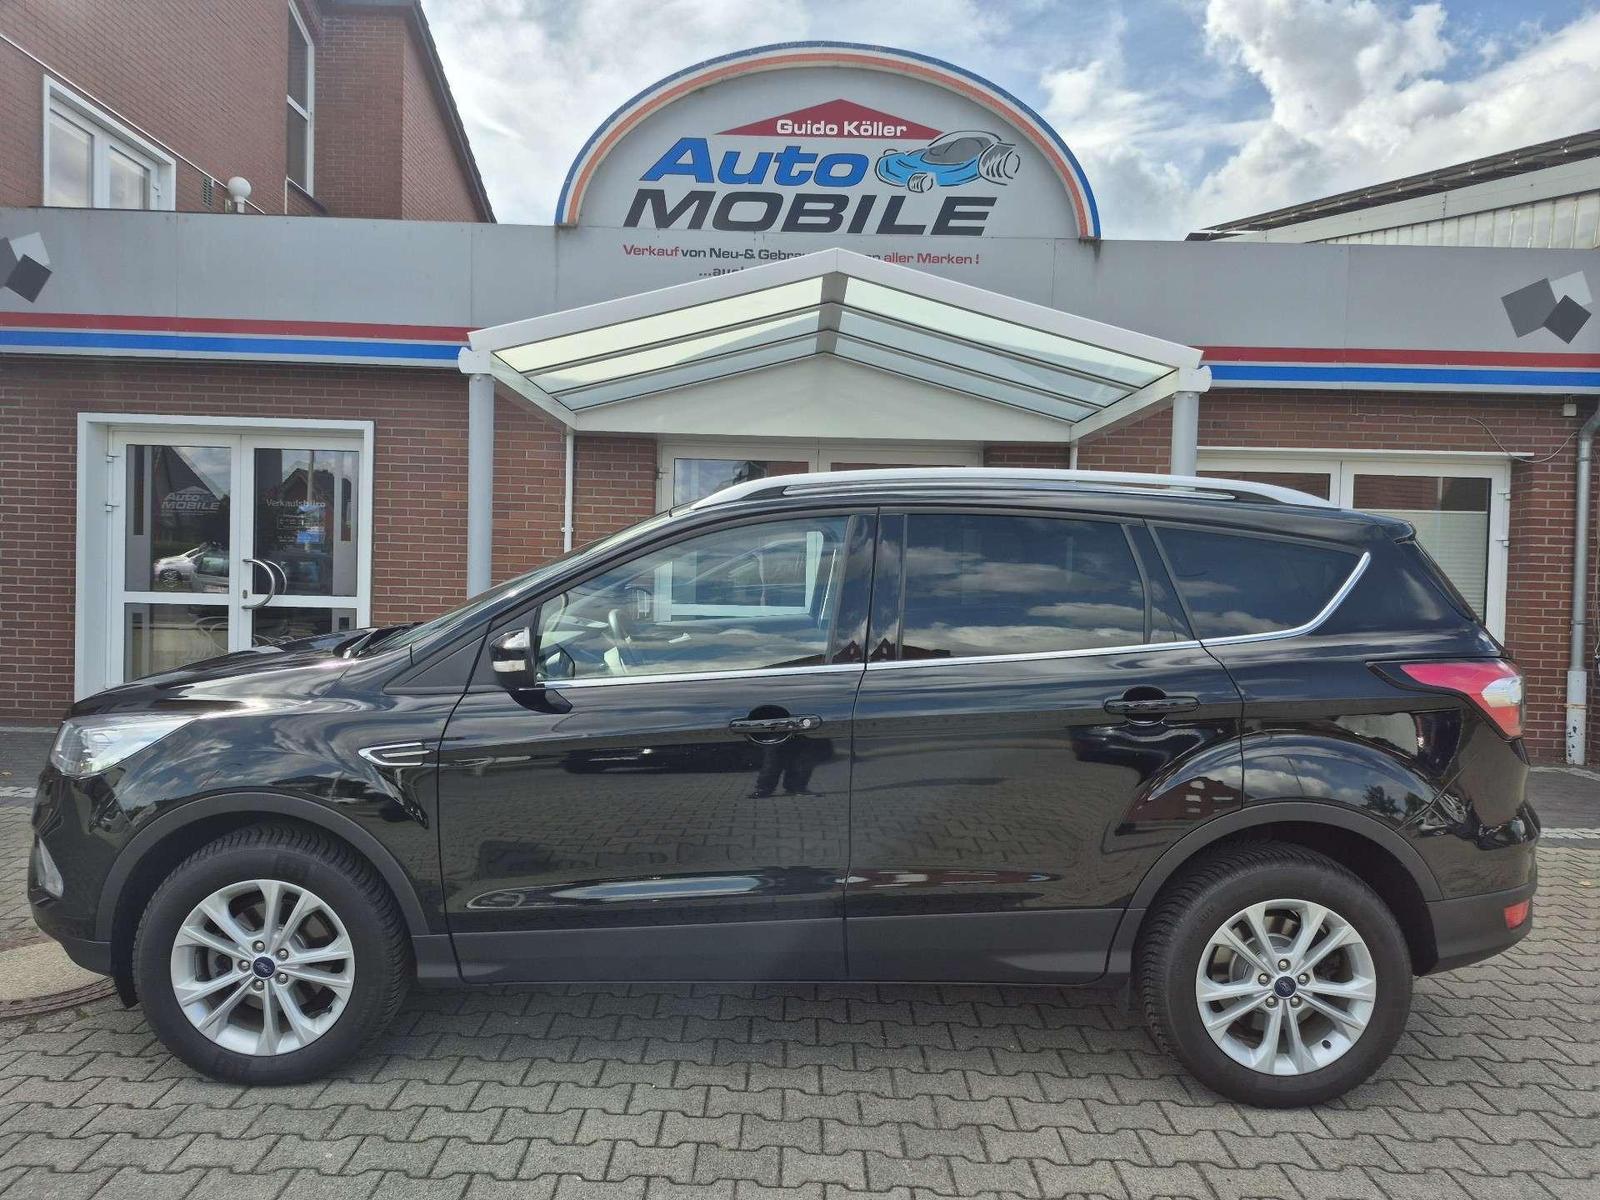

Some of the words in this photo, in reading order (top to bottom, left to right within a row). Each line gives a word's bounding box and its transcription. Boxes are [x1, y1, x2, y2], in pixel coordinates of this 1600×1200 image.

[776, 119, 838, 136] Guido
[843, 120, 907, 138] Köller
[638, 137, 869, 188] Auto
[623, 188, 997, 236] MOBILE
[623, 244, 679, 257] Verkauf
[681, 249, 706, 259] von
[884, 252, 913, 264] aller
[161, 501, 221, 510] MOBILE
